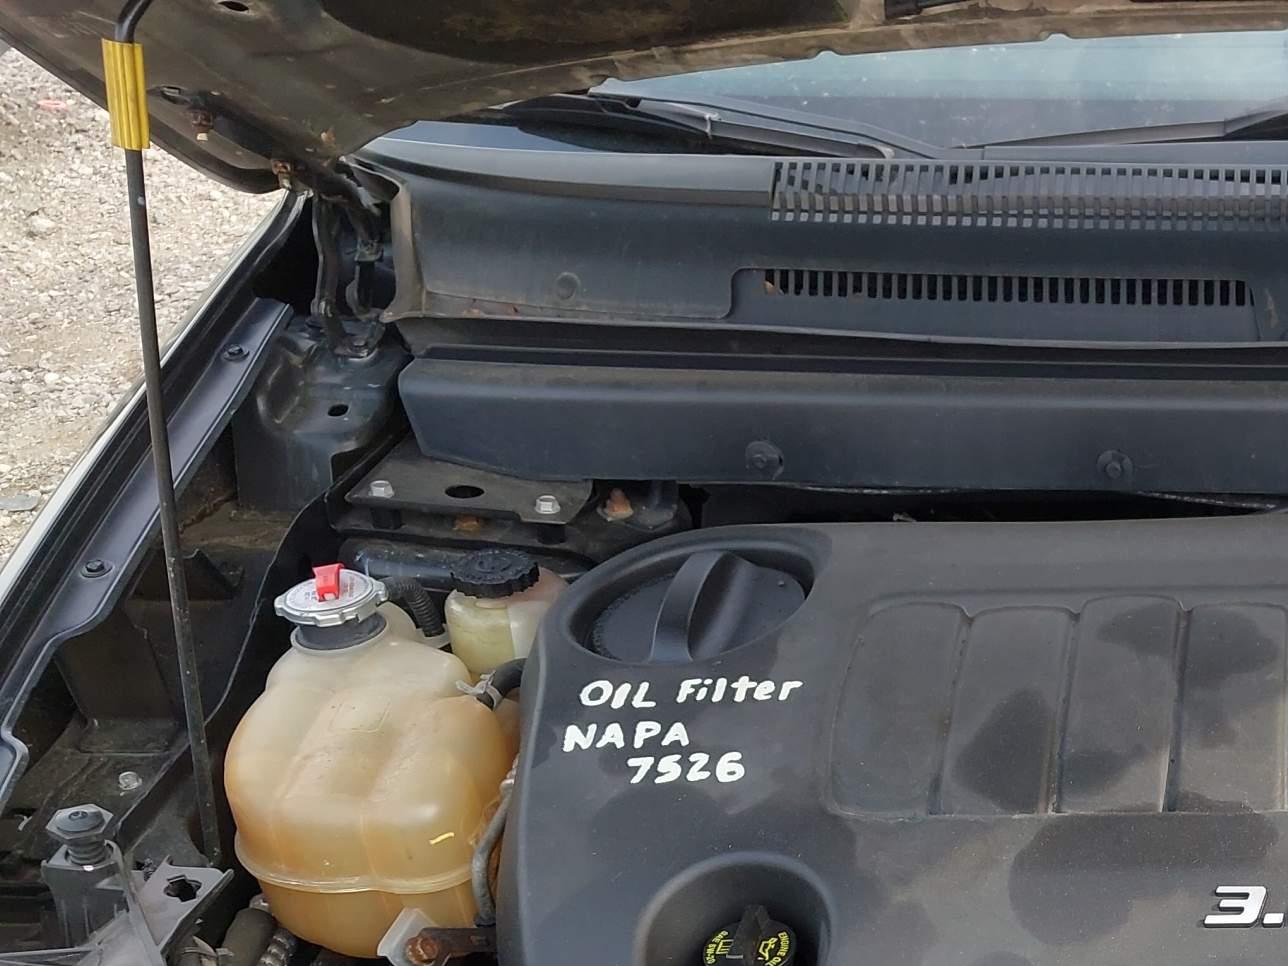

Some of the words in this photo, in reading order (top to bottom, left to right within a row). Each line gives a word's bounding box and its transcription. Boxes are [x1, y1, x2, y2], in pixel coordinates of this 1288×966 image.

[579, 680, 656, 709] OIL
[675, 675, 804, 703] Filter
[562, 721, 690, 752] NAPA
[627, 752, 746, 784] 7526
[777, 931, 790, 957] ENGINE
[764, 956, 782, 966] OIL
